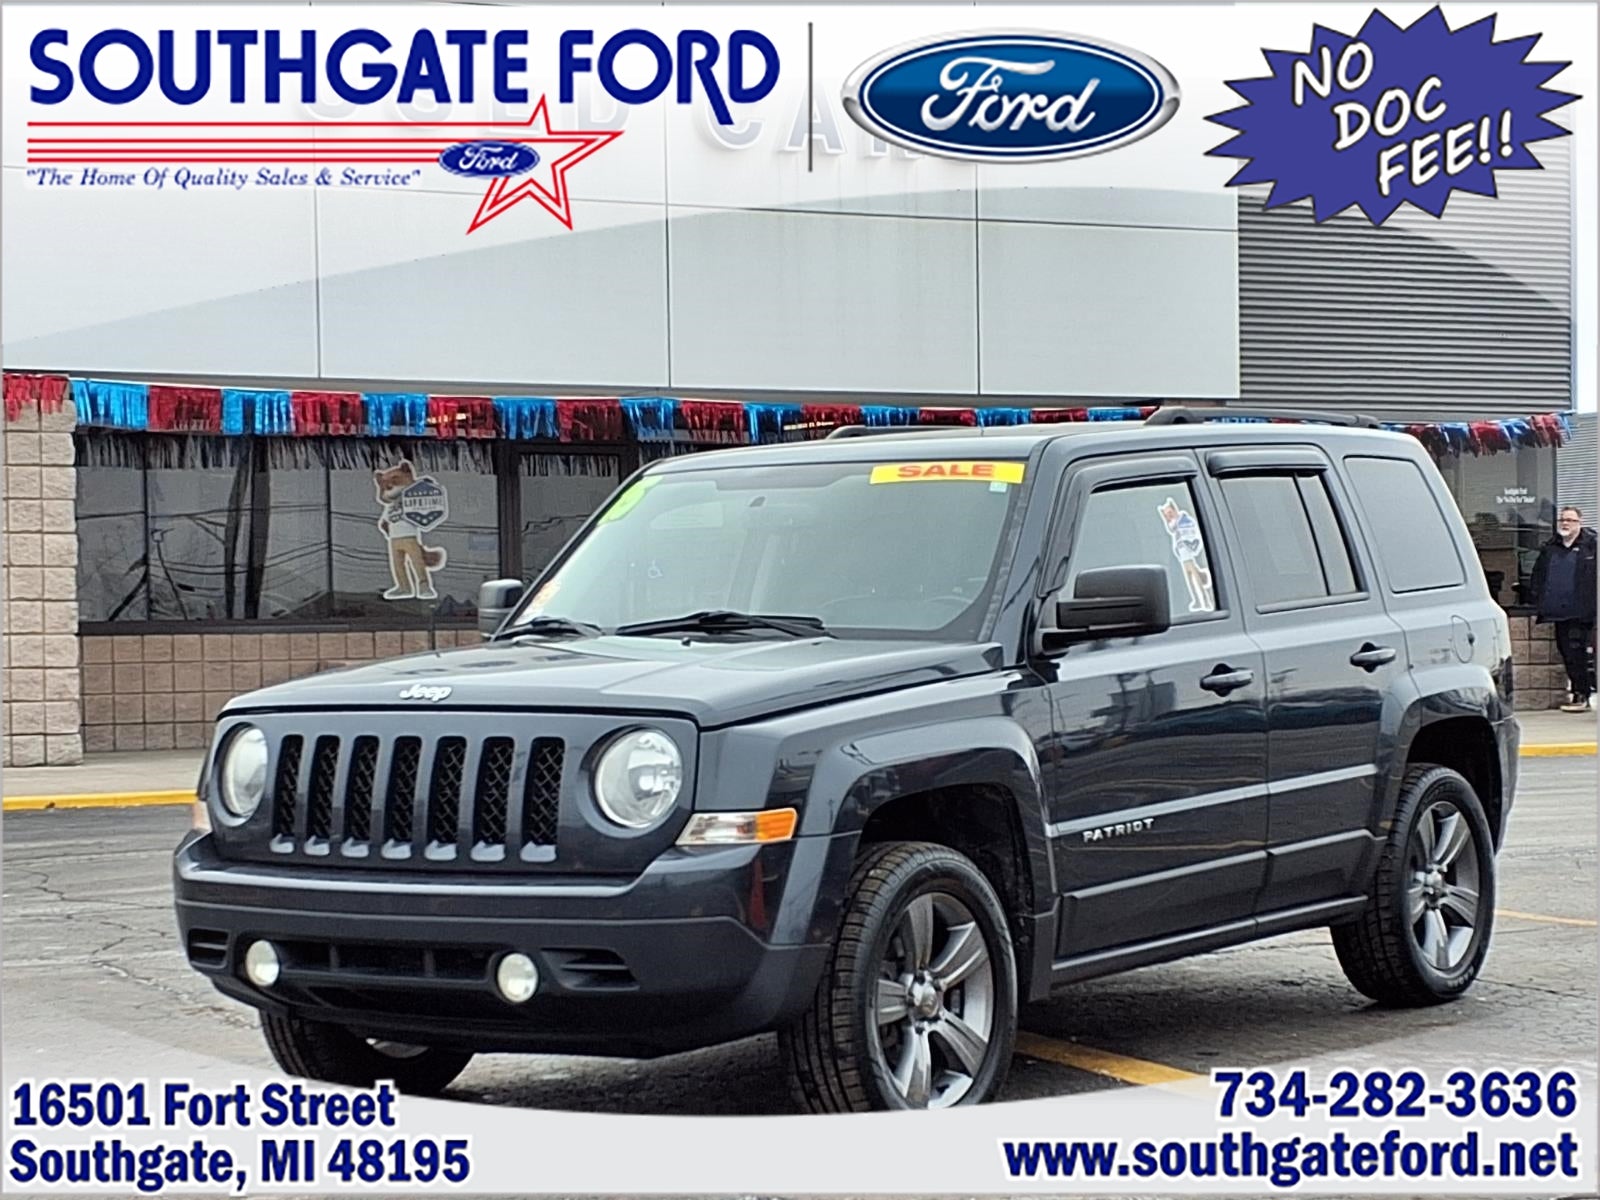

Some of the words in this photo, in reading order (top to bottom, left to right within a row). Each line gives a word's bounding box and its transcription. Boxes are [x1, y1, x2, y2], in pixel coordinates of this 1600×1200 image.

[898, 464, 994, 478] SALE
[399, 683, 452, 702] Jeep
[1082, 817, 1154, 843] PATRIOT
